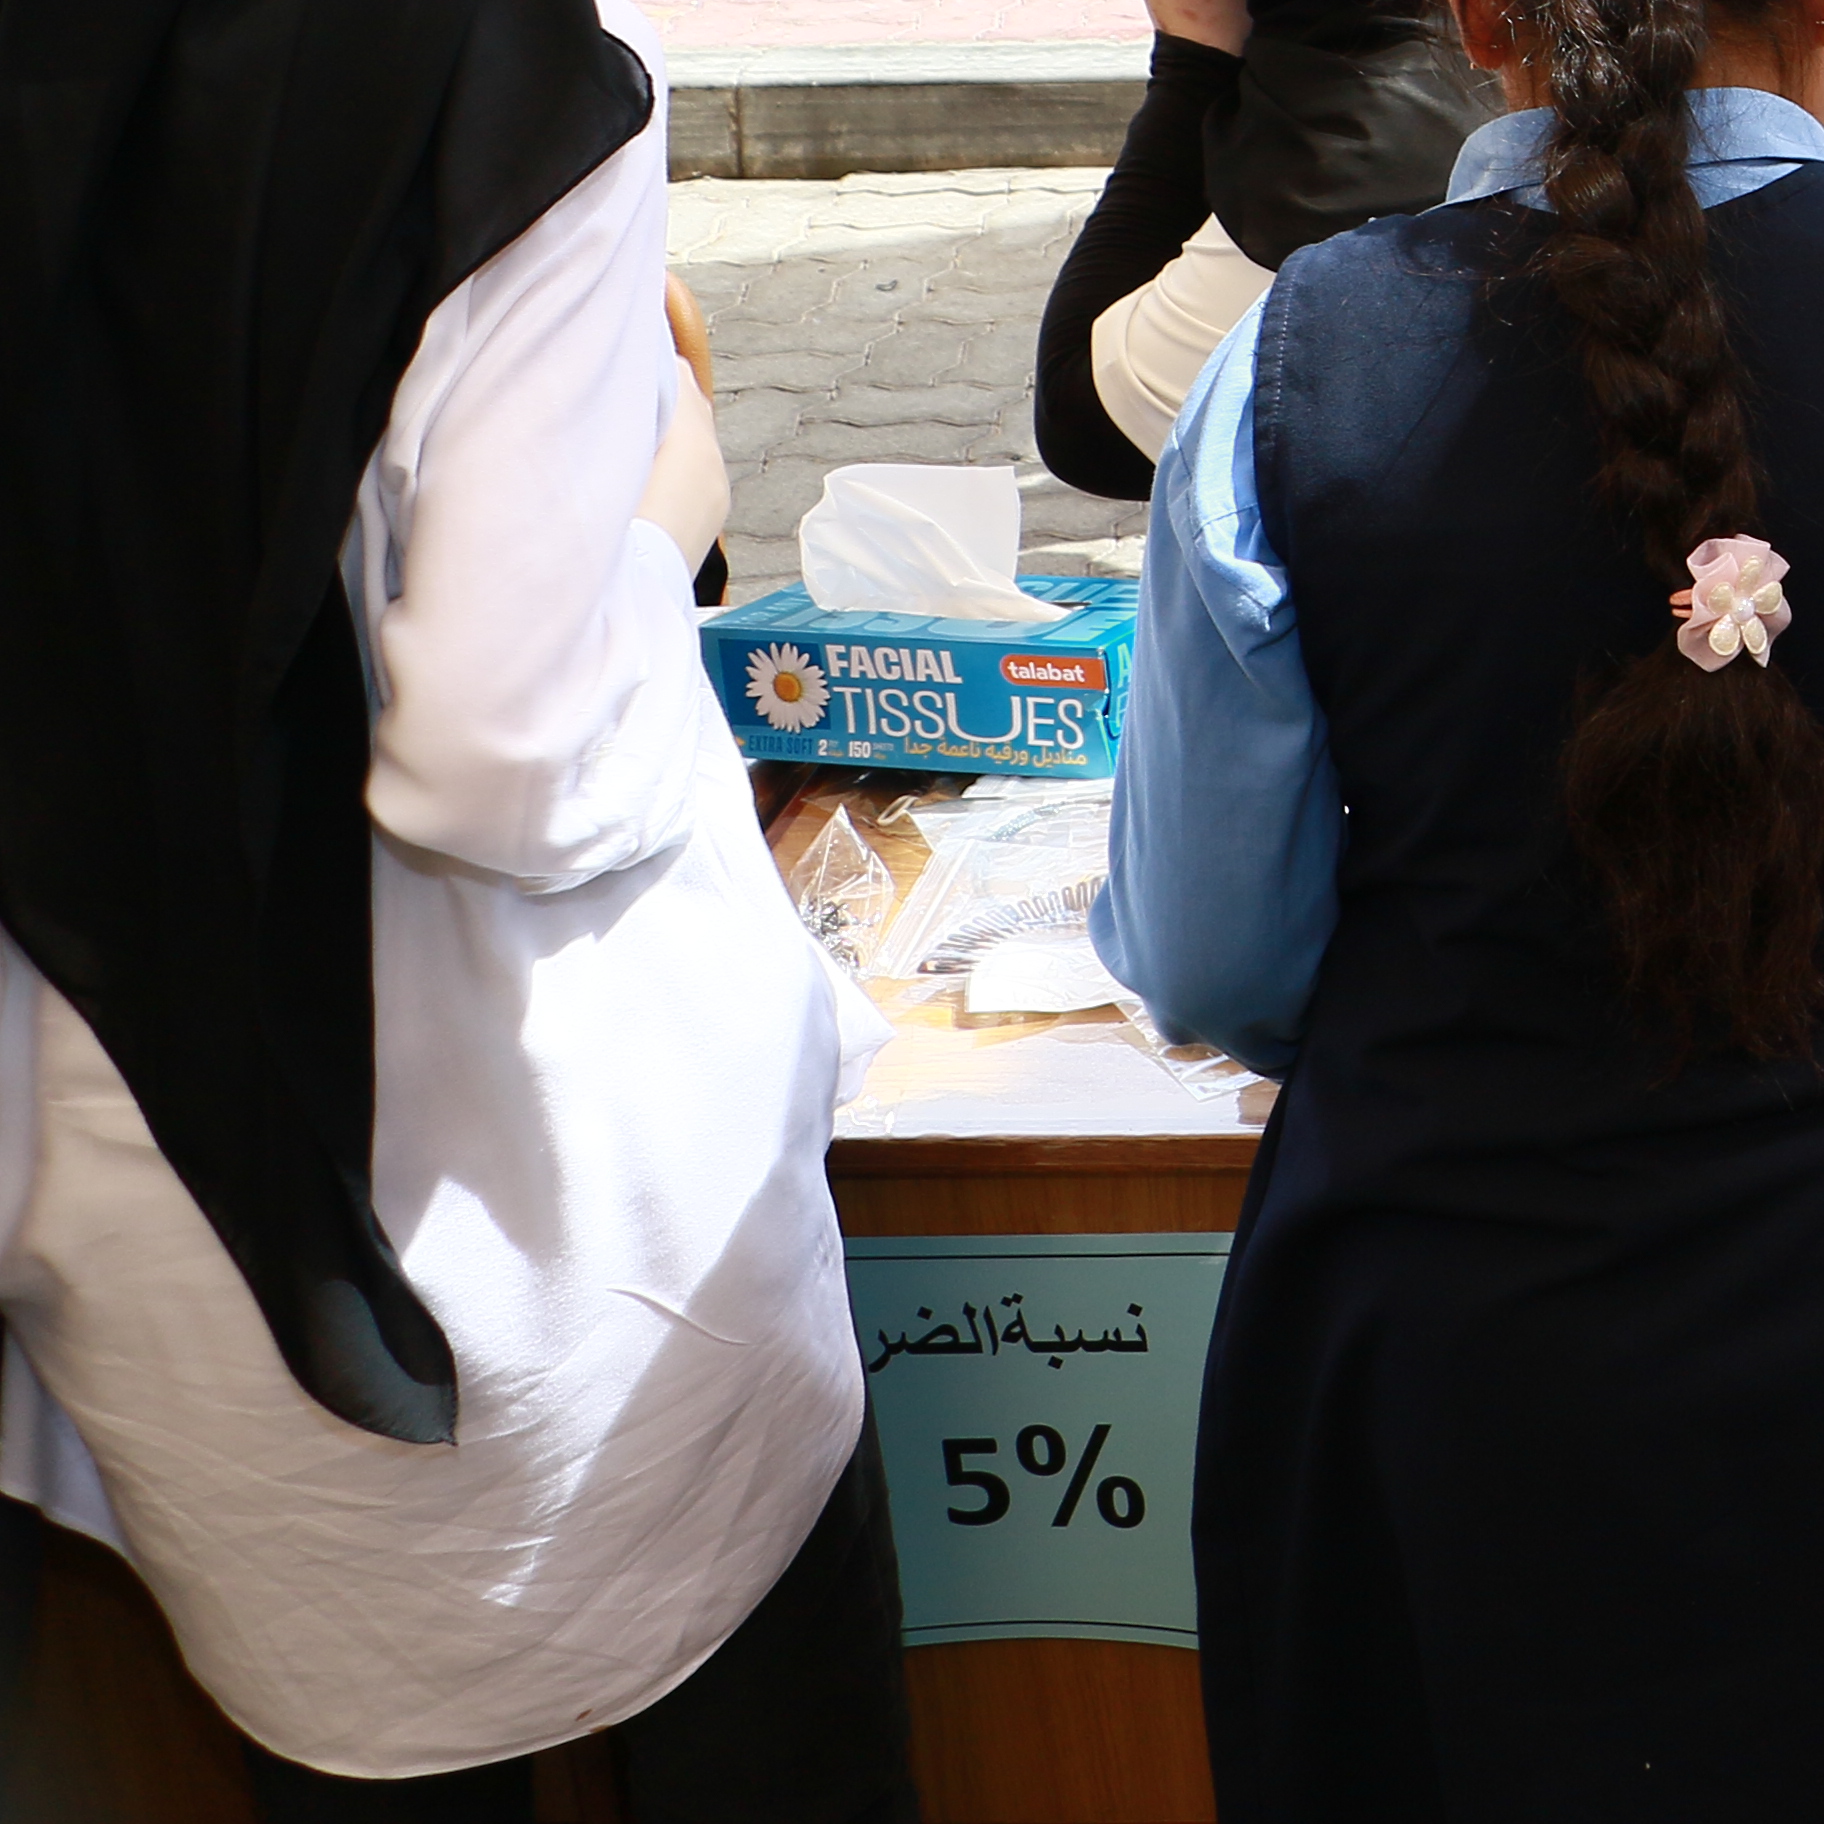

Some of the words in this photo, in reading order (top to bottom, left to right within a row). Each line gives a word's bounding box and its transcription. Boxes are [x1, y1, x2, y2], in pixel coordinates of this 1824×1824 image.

[825, 644, 963, 684] FACIAL
[1007, 661, 1085, 683] talabat
[832, 686, 1085, 750] TISSUES
[750, 734, 782, 752] EXTRA
[787, 737, 814, 755] SOFT
[817, 739, 828, 756] 2
[848, 741, 871, 758] 150
[904, 736, 933, 759] جدا
[868, 1300, 999, 1374] الضر
[1001, 1292, 1148, 1370] نسبة
[941, 1423, 1146, 1529] 5%
